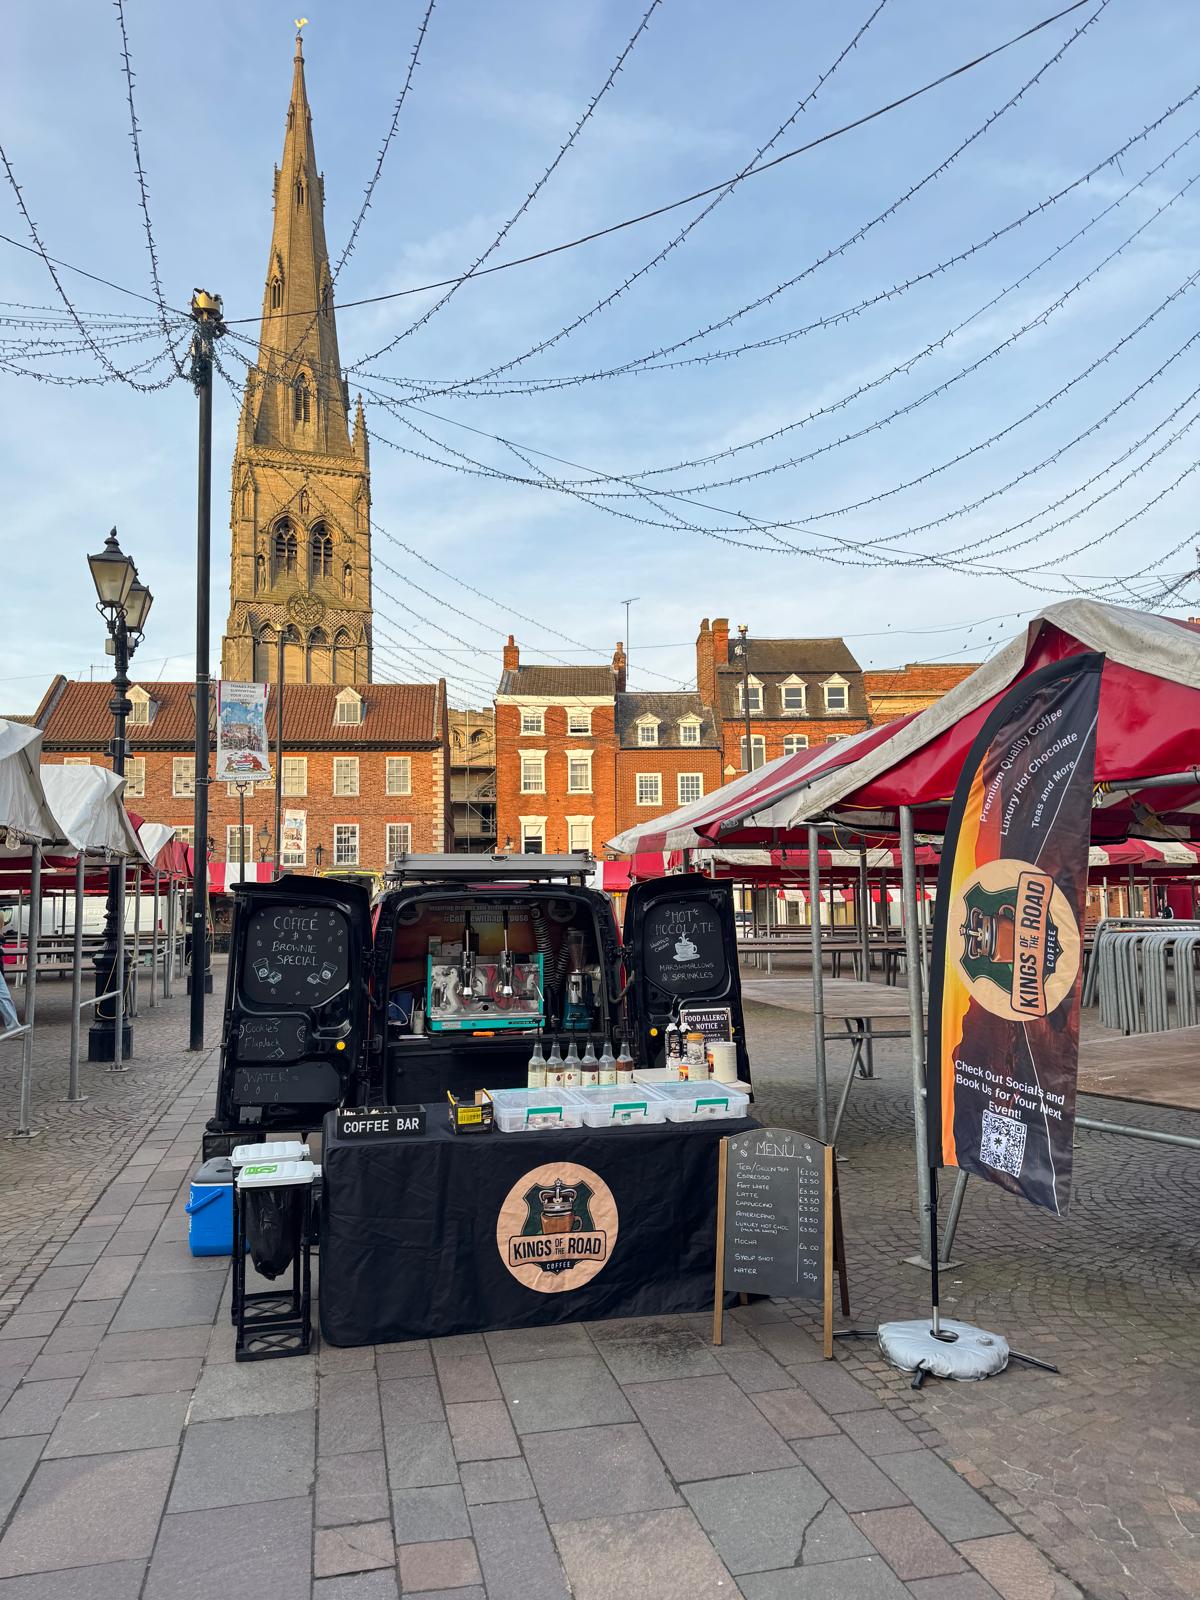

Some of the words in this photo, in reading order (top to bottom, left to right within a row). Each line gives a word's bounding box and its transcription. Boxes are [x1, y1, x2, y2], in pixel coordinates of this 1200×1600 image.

[980, 772, 1005, 823] Premium
[1001, 735, 1031, 770] Quality
[1029, 708, 1063, 736] Coffee
[1000, 796, 1021, 836] Luxury
[1014, 774, 1031, 792] Hot
[1029, 731, 1078, 773] Chocolate
[1031, 803, 1044, 828] Teas
[1041, 781, 1054, 802] and
[1053, 760, 1076, 782] More
[1021, 880, 1045, 932] ROAD
[274, 916, 319, 930] COFFEE
[672, 911, 692, 923] HOT
[272, 941, 317, 954] BROWNIE
[1020, 935, 1028, 948] OF
[1030, 935, 1039, 949] THE
[1046, 929, 1056, 968] COFFEE
[276, 955, 319, 966] SPECIAL
[659, 962, 714, 972] MARSHMALLOWS
[672, 972, 713, 981] SPRINKLES
[1020, 953, 1040, 1009] KINGS
[247, 1071, 288, 1082] WATER
[955, 1060, 983, 1076] Check
[985, 1071, 1004, 1086] Out
[1005, 1076, 1044, 1098] Socials
[1046, 1090, 1065, 1106] and
[955, 1074, 981, 1090] Book
[982, 1083, 992, 1096] Us
[994, 1088, 1011, 1102] for
[1013, 1093, 1038, 1112] Your
[1040, 1103, 1063, 1121] Next
[988, 1100, 1022, 1120] Event!
[343, 1120, 389, 1133] COFFEE
[396, 1118, 419, 1131] BAR
[757, 1141, 795, 1157] MENU
[736, 1211, 776, 1219] AMERICANO
[513, 1239, 552, 1260] KINGS
[555, 1238, 563, 1247] OF
[568, 1237, 601, 1254] ROAD
[734, 1253, 756, 1261] SYRUP
[546, 1261, 571, 1270] COFFEE
[803, 1272, 818, 1282] 50p
